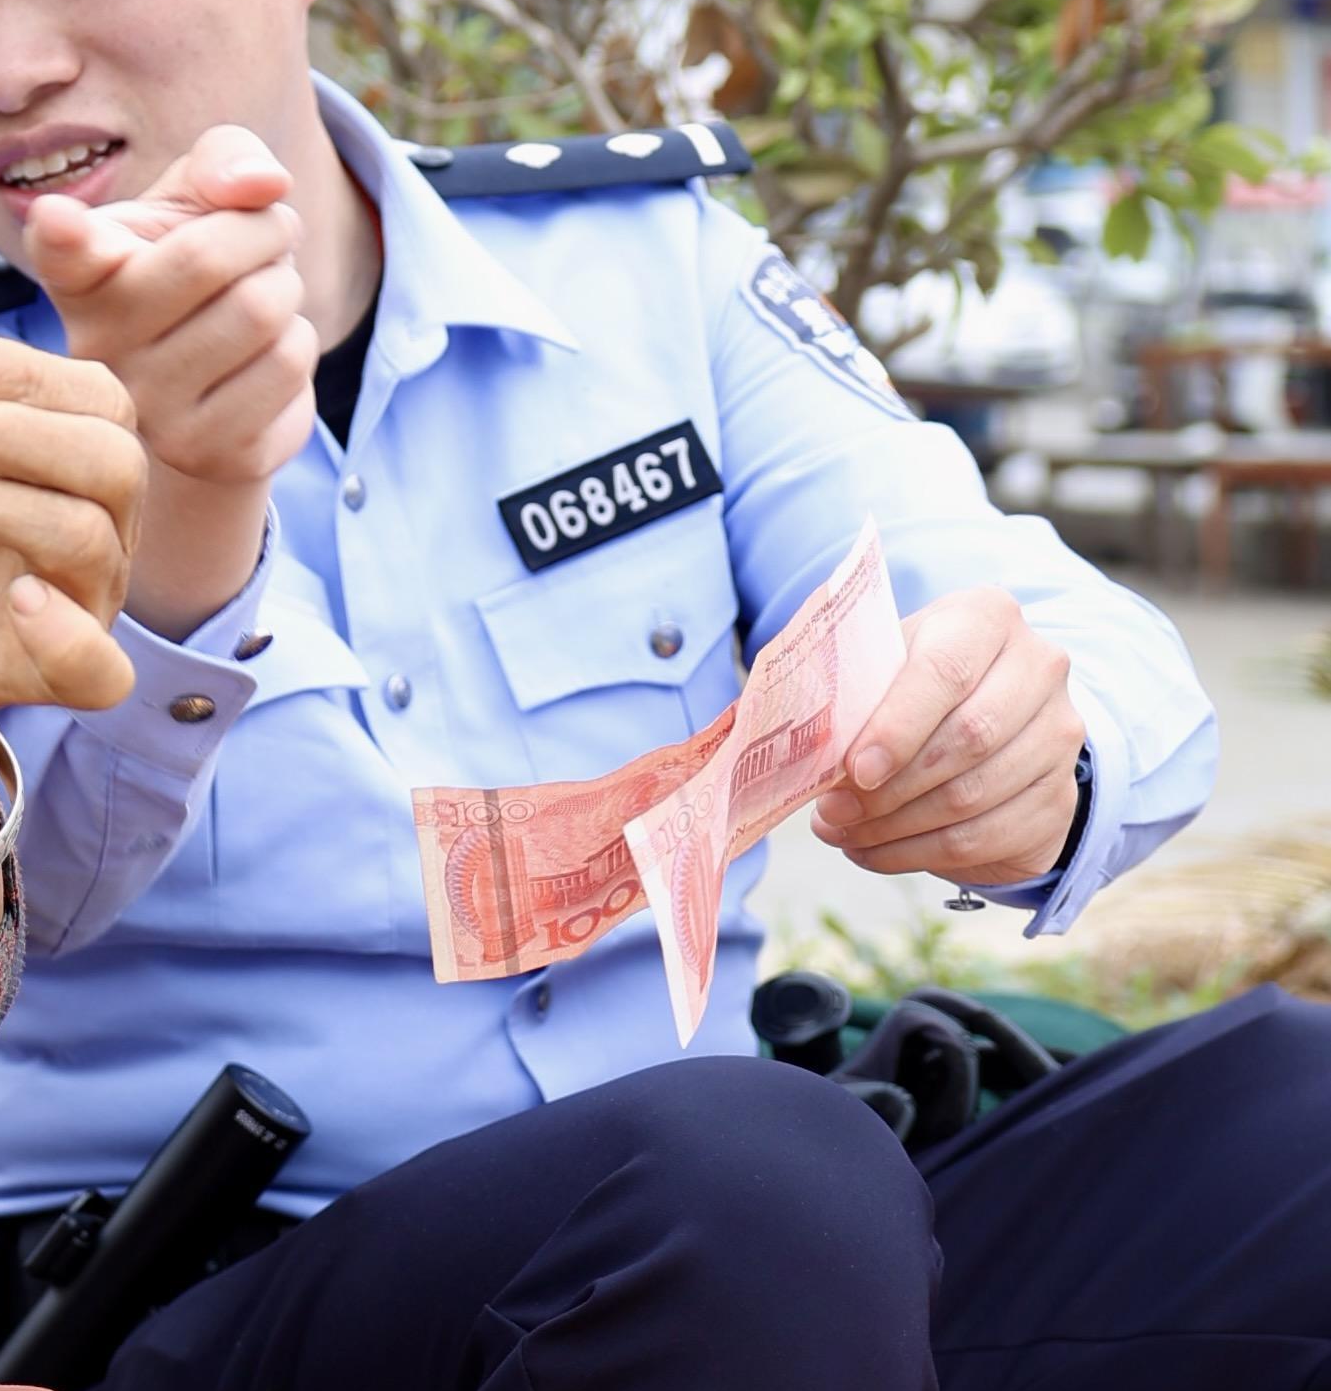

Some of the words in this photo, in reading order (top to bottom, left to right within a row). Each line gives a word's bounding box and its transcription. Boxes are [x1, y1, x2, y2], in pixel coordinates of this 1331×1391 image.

[519, 436, 697, 551] 068467
[449, 799, 536, 828] 100
[658, 783, 715, 855] 100
[540, 879, 639, 952] 100
